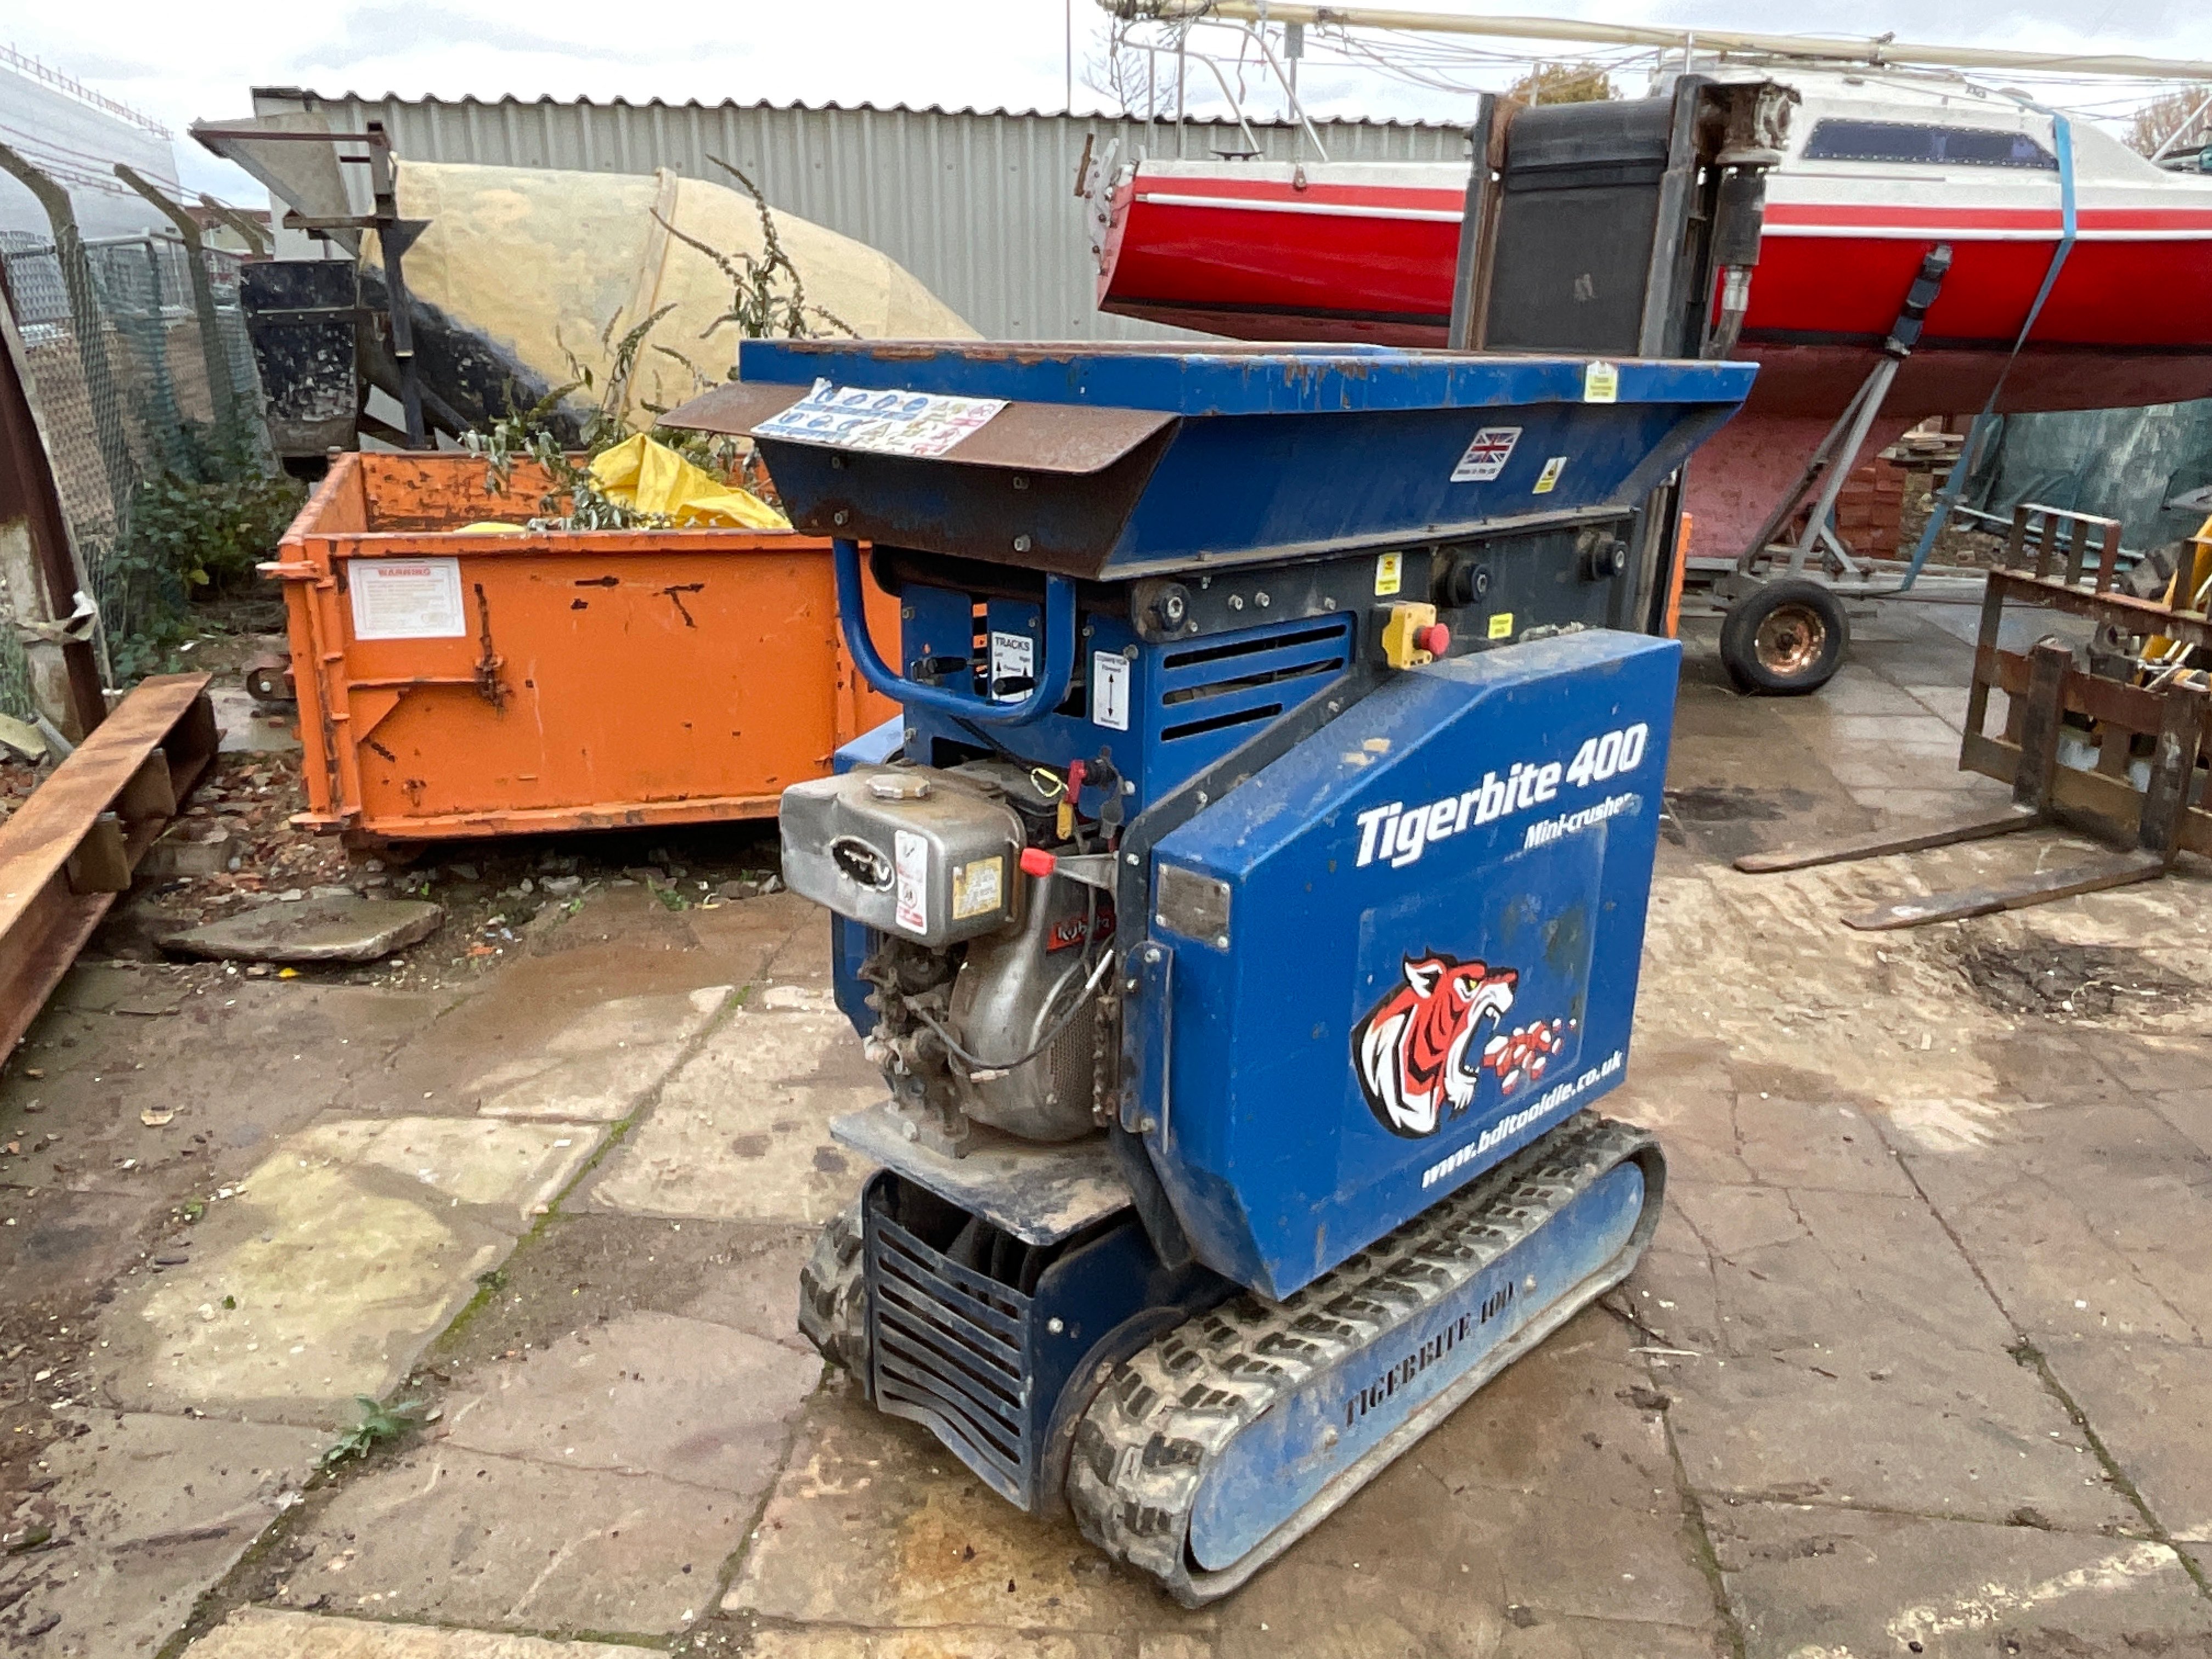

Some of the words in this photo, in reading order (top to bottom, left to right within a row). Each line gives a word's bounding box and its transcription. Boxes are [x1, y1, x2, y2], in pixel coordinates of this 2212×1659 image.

[995, 636, 1030, 651] TRACKS
[1355, 761, 1562, 869] Tigerbite
[1565, 722, 1649, 787] 400
[1057, 916, 1109, 941] Kubta
[1345, 1312, 1471, 1427] TIGERBITE
